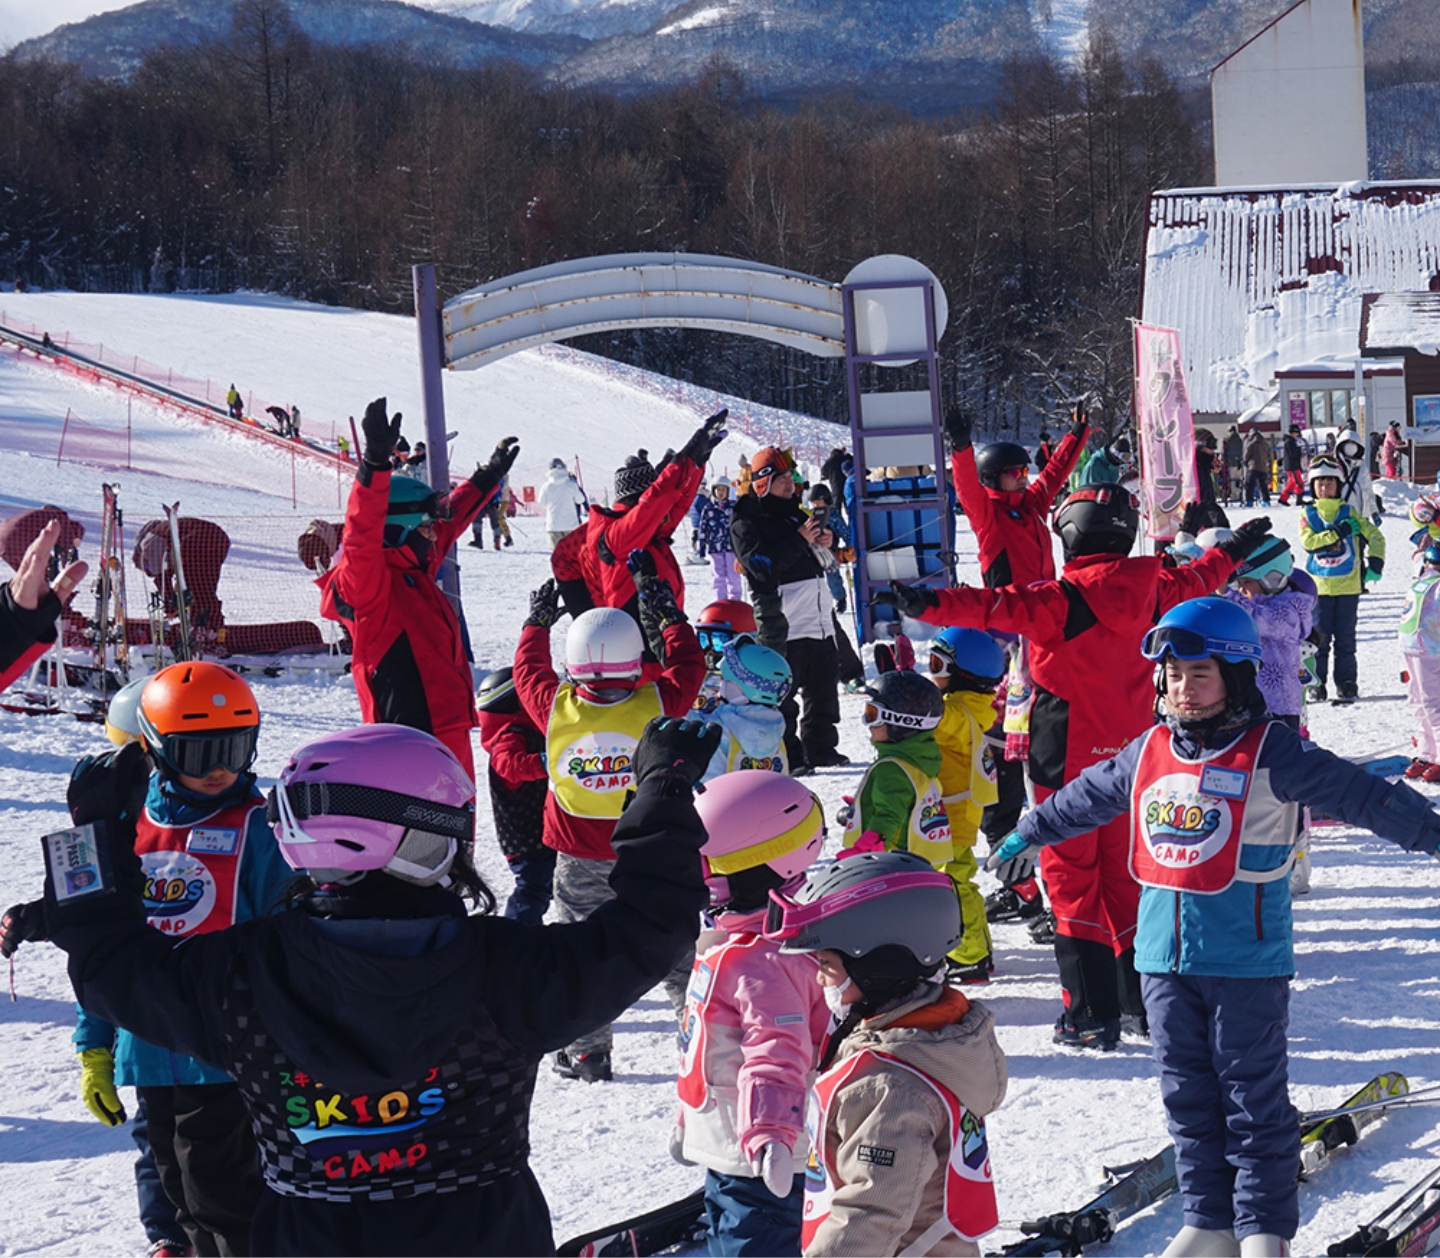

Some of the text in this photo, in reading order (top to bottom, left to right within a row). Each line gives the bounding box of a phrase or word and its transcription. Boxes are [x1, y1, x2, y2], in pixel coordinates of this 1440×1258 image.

[881, 710, 926, 728] uvex
[568, 755, 632, 776] SKID
[582, 774, 632, 790] CAMP
[402, 804, 467, 832] SWANS
[1145, 800, 1222, 831] SKIDS
[66, 843, 80, 868] PASS
[1155, 845, 1200, 864] CAMP
[143, 878, 204, 901] KIDS
[286, 1087, 446, 1128] SKIDS
[324, 1143, 428, 1180] CAMP
